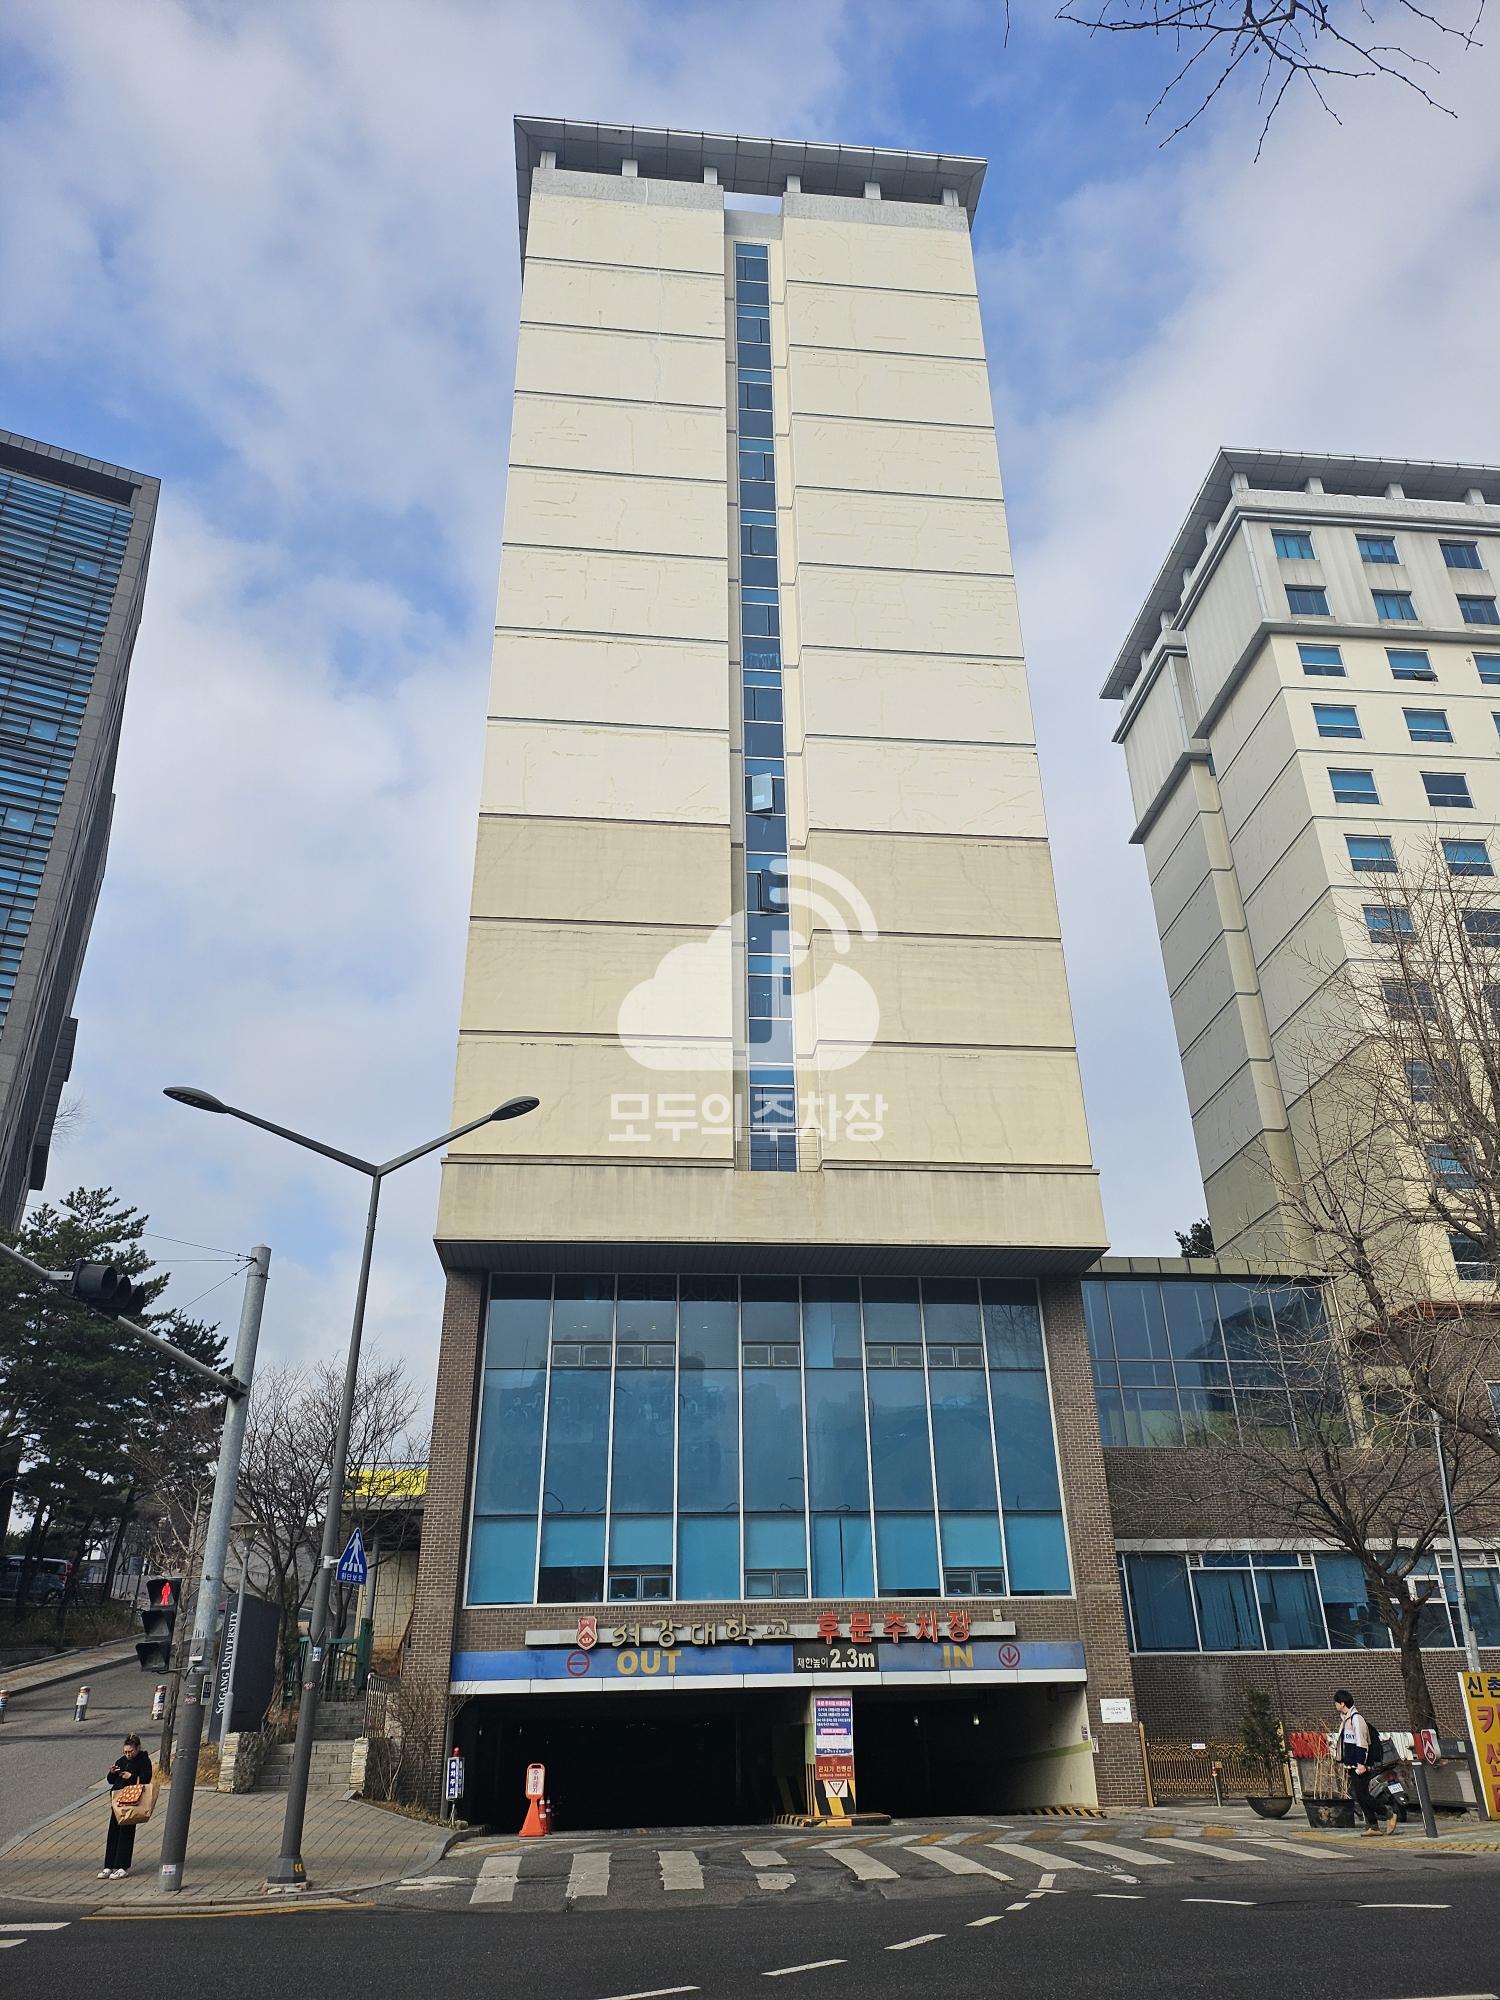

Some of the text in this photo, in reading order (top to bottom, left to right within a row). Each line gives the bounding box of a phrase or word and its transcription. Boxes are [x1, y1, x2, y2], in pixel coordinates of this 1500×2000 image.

[611, 1613, 797, 1648] 서강대학교
[215, 1611, 238, 1714] SOGANG UNIVERSITY
[616, 1650, 682, 1674] OUT
[797, 1648, 876, 1669] 제한높이 2.3m
[943, 1645, 974, 1668] IN
